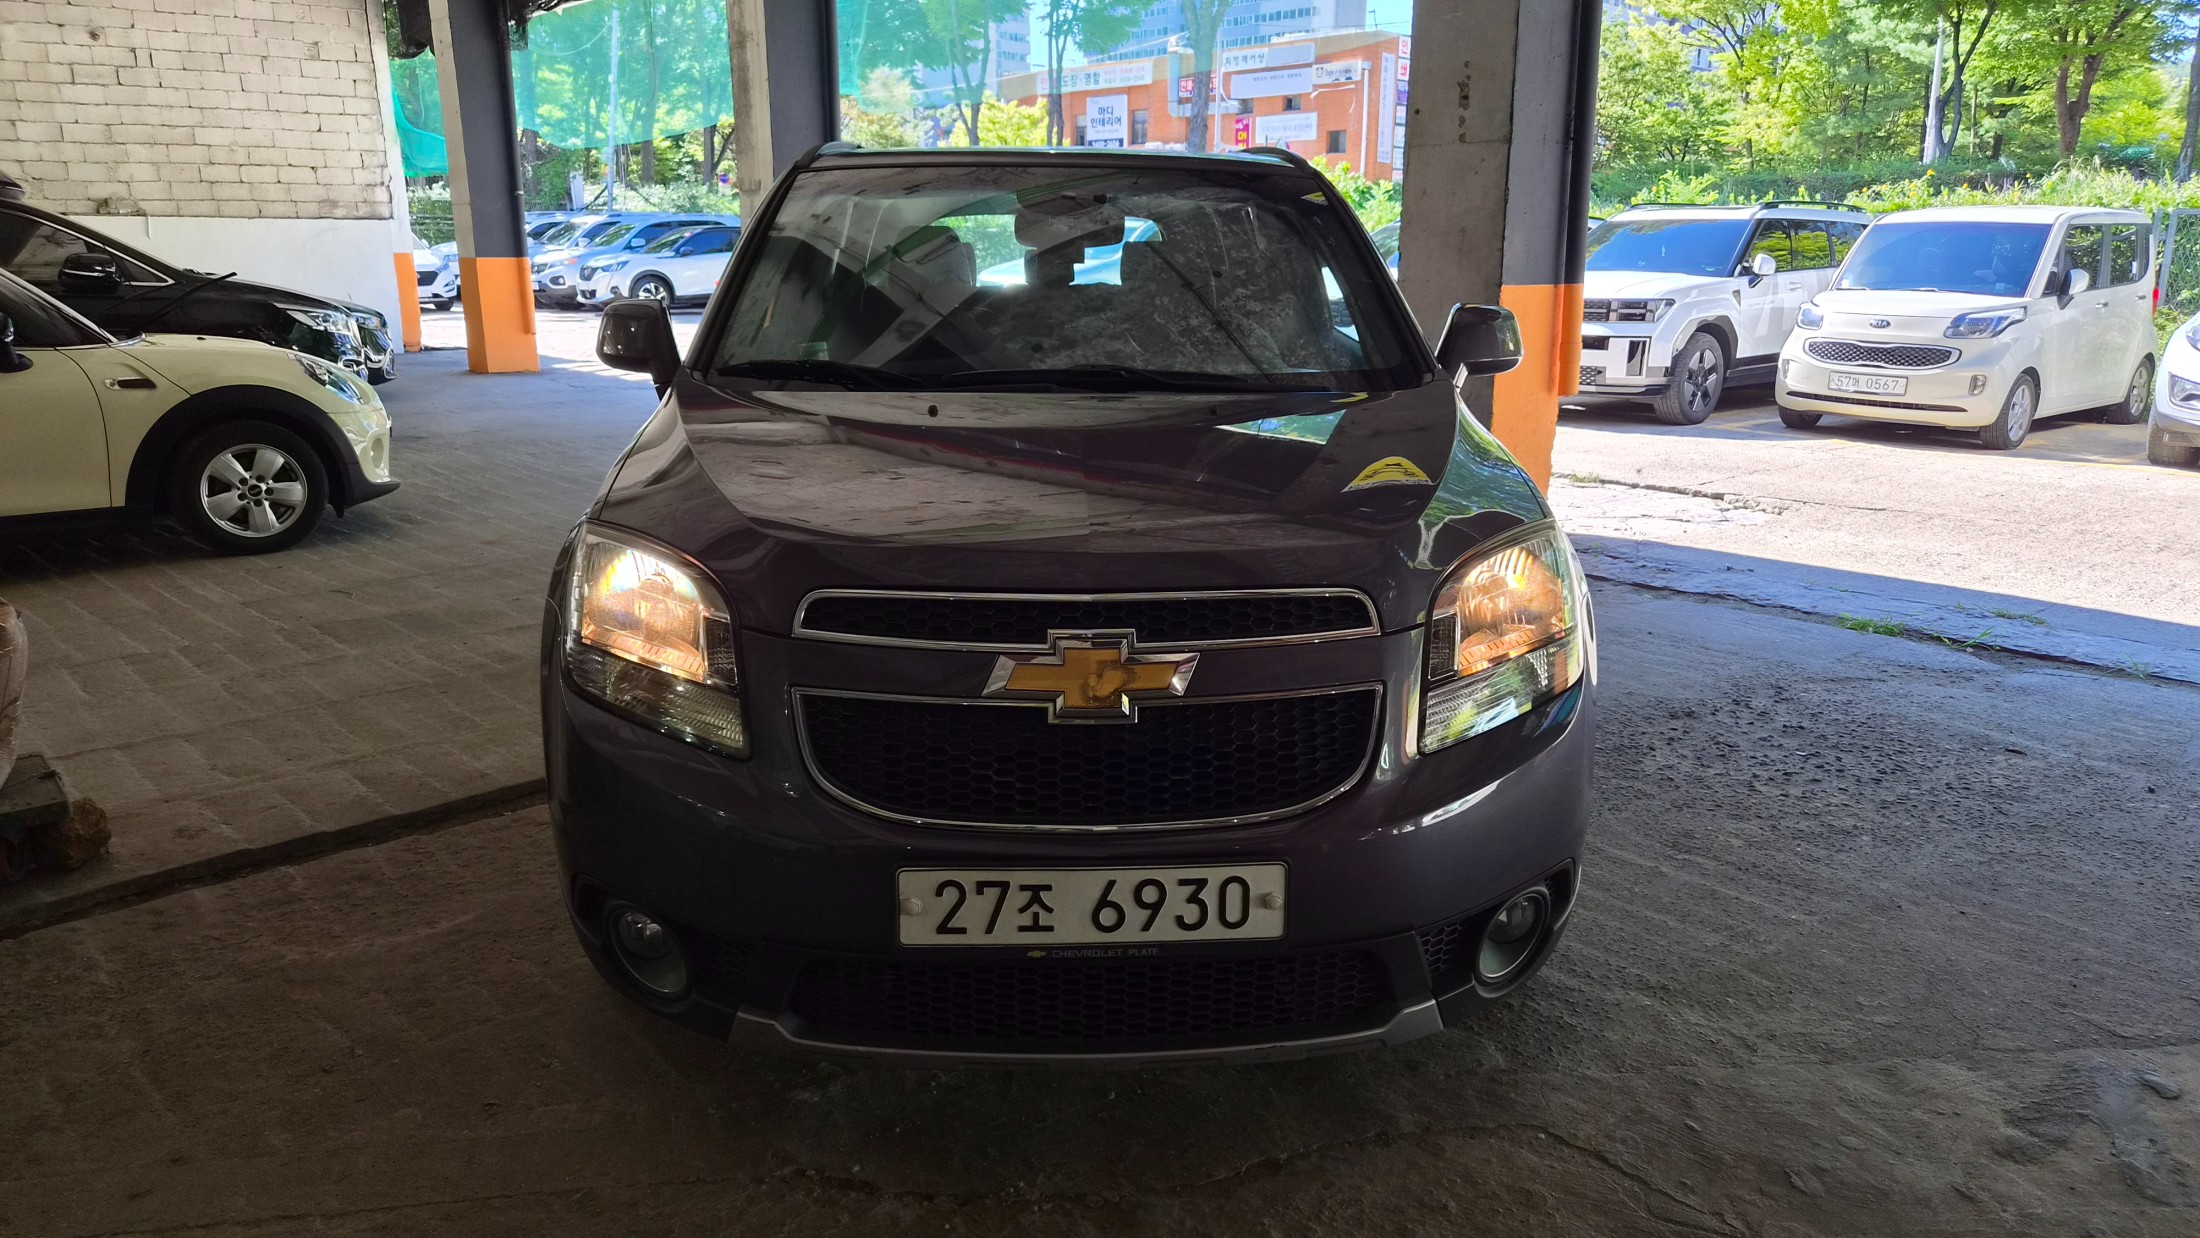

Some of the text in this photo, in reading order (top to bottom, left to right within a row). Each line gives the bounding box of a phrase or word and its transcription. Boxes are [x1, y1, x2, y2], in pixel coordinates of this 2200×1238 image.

[1090, 115, 1122, 129] 인테리어
[1865, 377, 1899, 391] 0567
[934, 875, 1251, 935] 27조 6930
[1052, 947, 1159, 958] CHEVROLET PLATE
